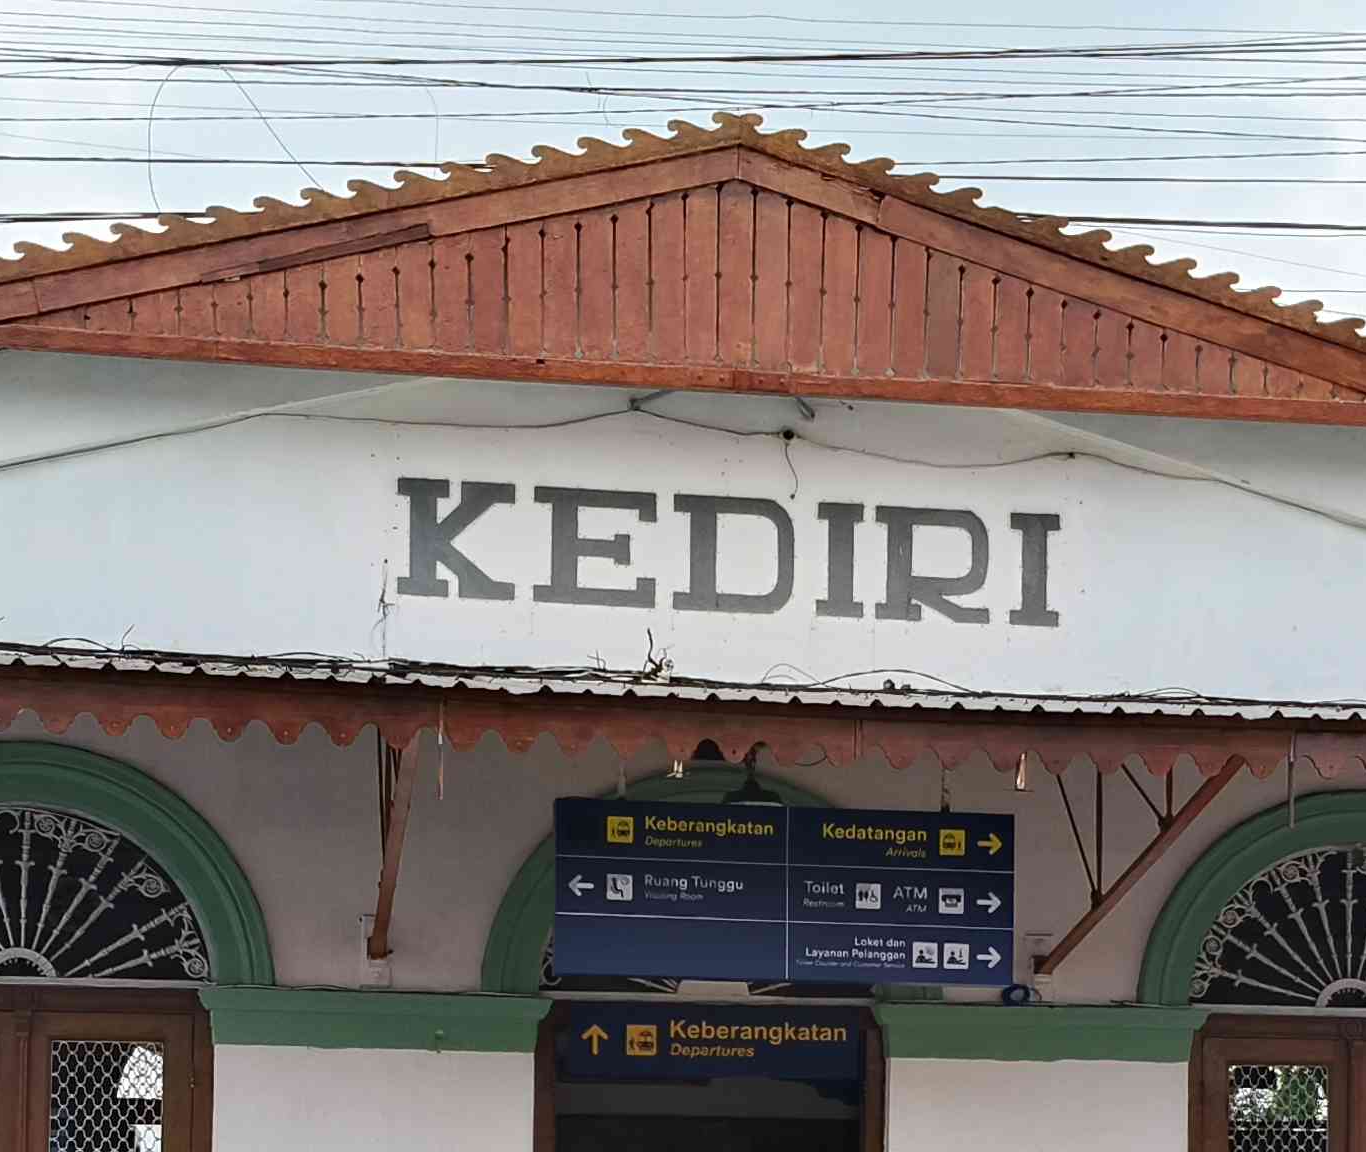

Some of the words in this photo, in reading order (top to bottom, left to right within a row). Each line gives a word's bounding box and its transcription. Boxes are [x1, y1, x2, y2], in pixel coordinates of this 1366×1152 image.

[396, 477, 1060, 627] KEDIRI
[644, 815, 774, 837] Keberangkatan
[644, 835, 703, 848] Departures
[822, 823, 928, 845] Kedatangan
[885, 847, 927, 859] Arrivals
[644, 874, 688, 890] Ruang
[691, 875, 744, 892] Tunggu
[803, 880, 845, 895] Toilet
[892, 886, 928, 900] ATM
[905, 904, 928, 913] ATM
[854, 936, 884, 948] Loket
[886, 938, 906, 948] dan
[805, 947, 849, 961] Layanan
[851, 948, 906, 962] Pelanggan
[669, 1019, 848, 1044] Keberangkatan
[669, 1043, 756, 1060] Departures
